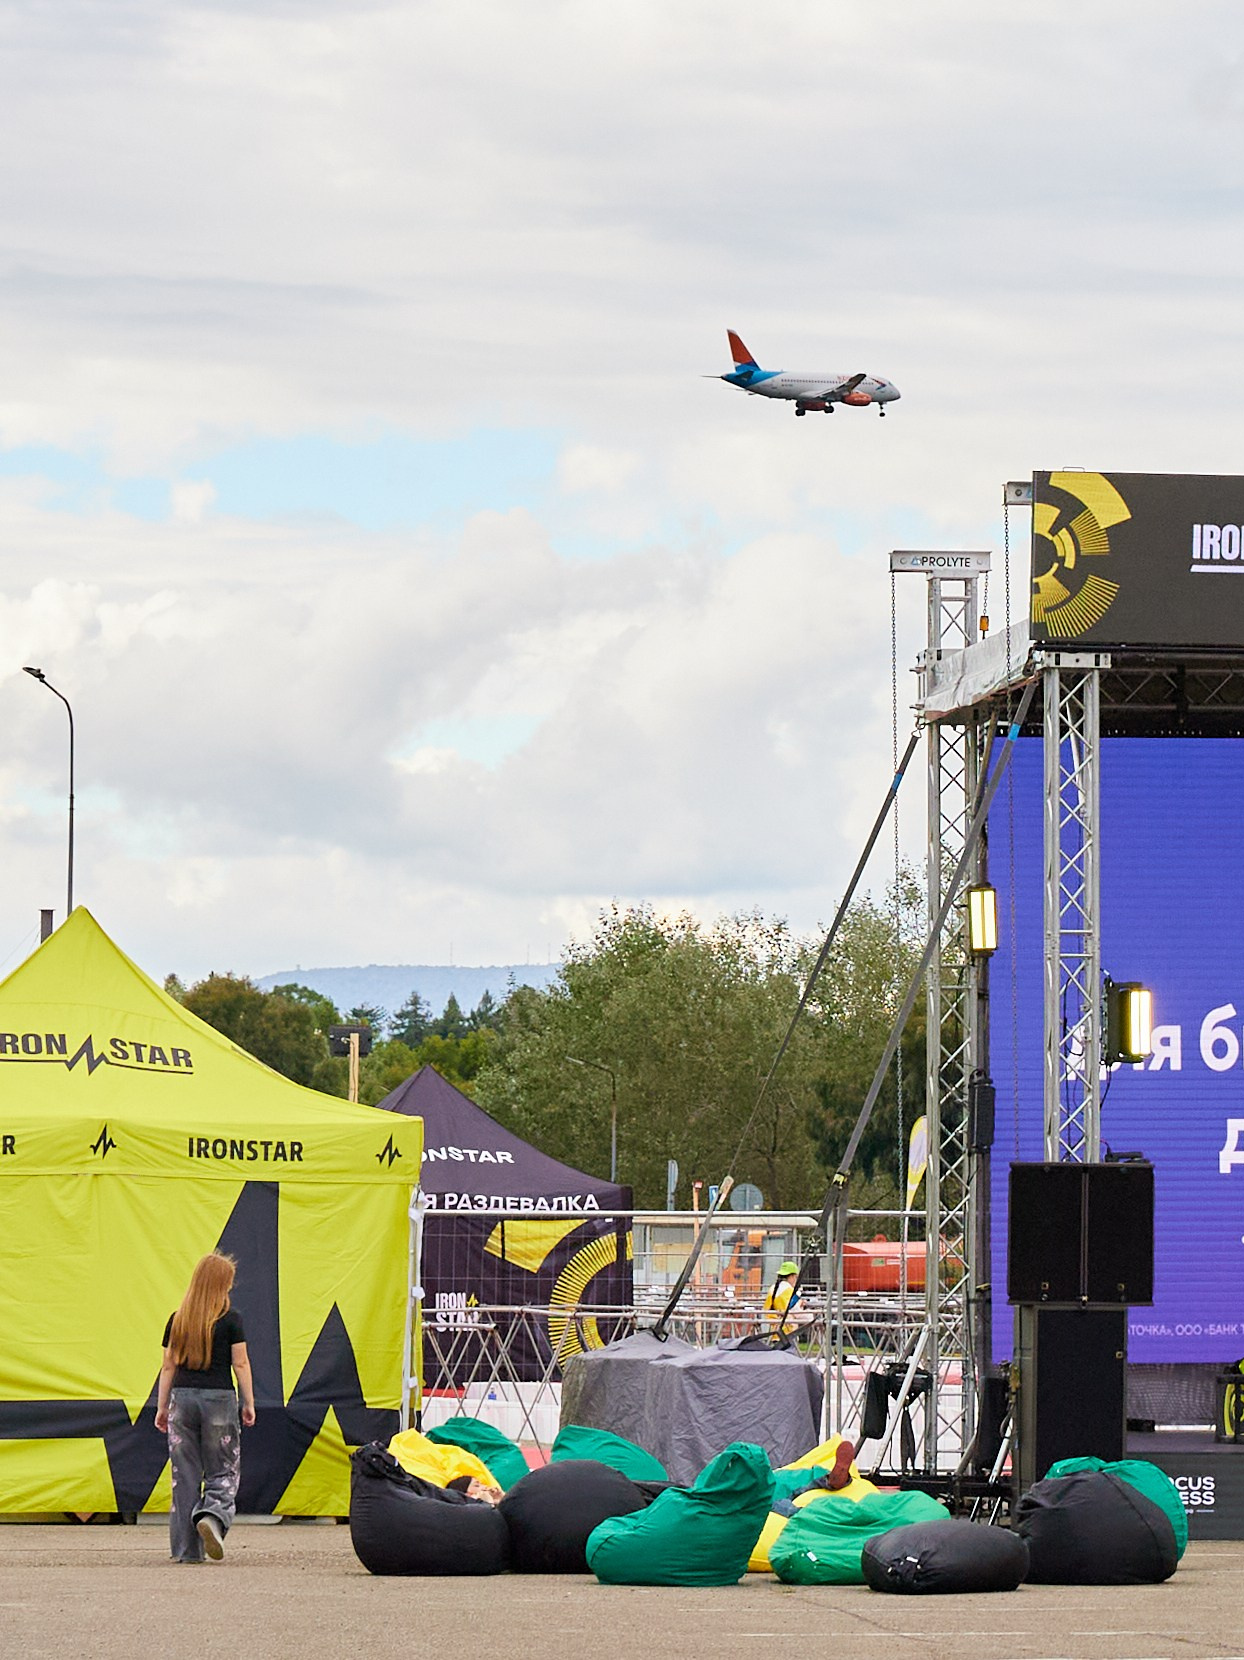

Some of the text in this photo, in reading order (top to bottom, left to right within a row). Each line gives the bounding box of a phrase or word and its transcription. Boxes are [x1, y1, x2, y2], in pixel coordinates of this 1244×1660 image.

[921, 556, 971, 568] PROLYTE
[109, 1037, 194, 1068] STAR
[189, 1136, 304, 1163] IRONSTAR
[445, 1193, 600, 1211] РАЗДЕВАЛКА
[435, 1292, 467, 1309] IRON
